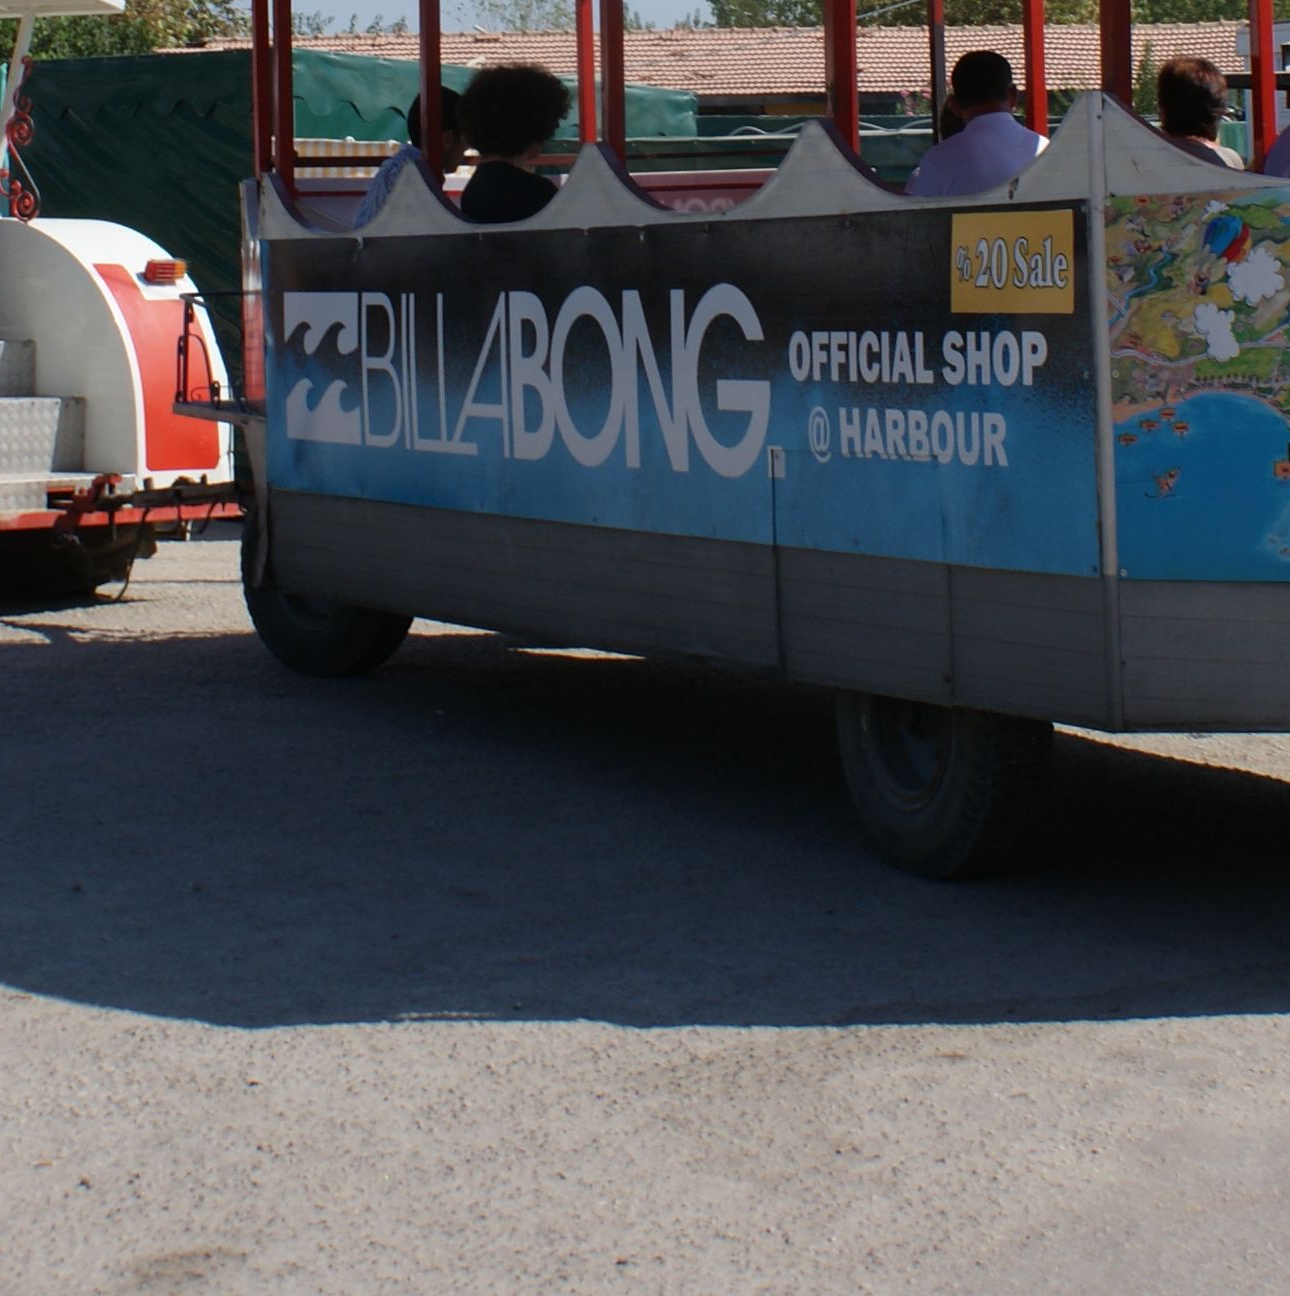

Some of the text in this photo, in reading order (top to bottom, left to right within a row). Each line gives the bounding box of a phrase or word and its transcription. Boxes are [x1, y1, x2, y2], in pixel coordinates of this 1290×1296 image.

[1013, 234, 1068, 289] Sale
[788, 330, 1048, 386] OFFICIAL SHOP
